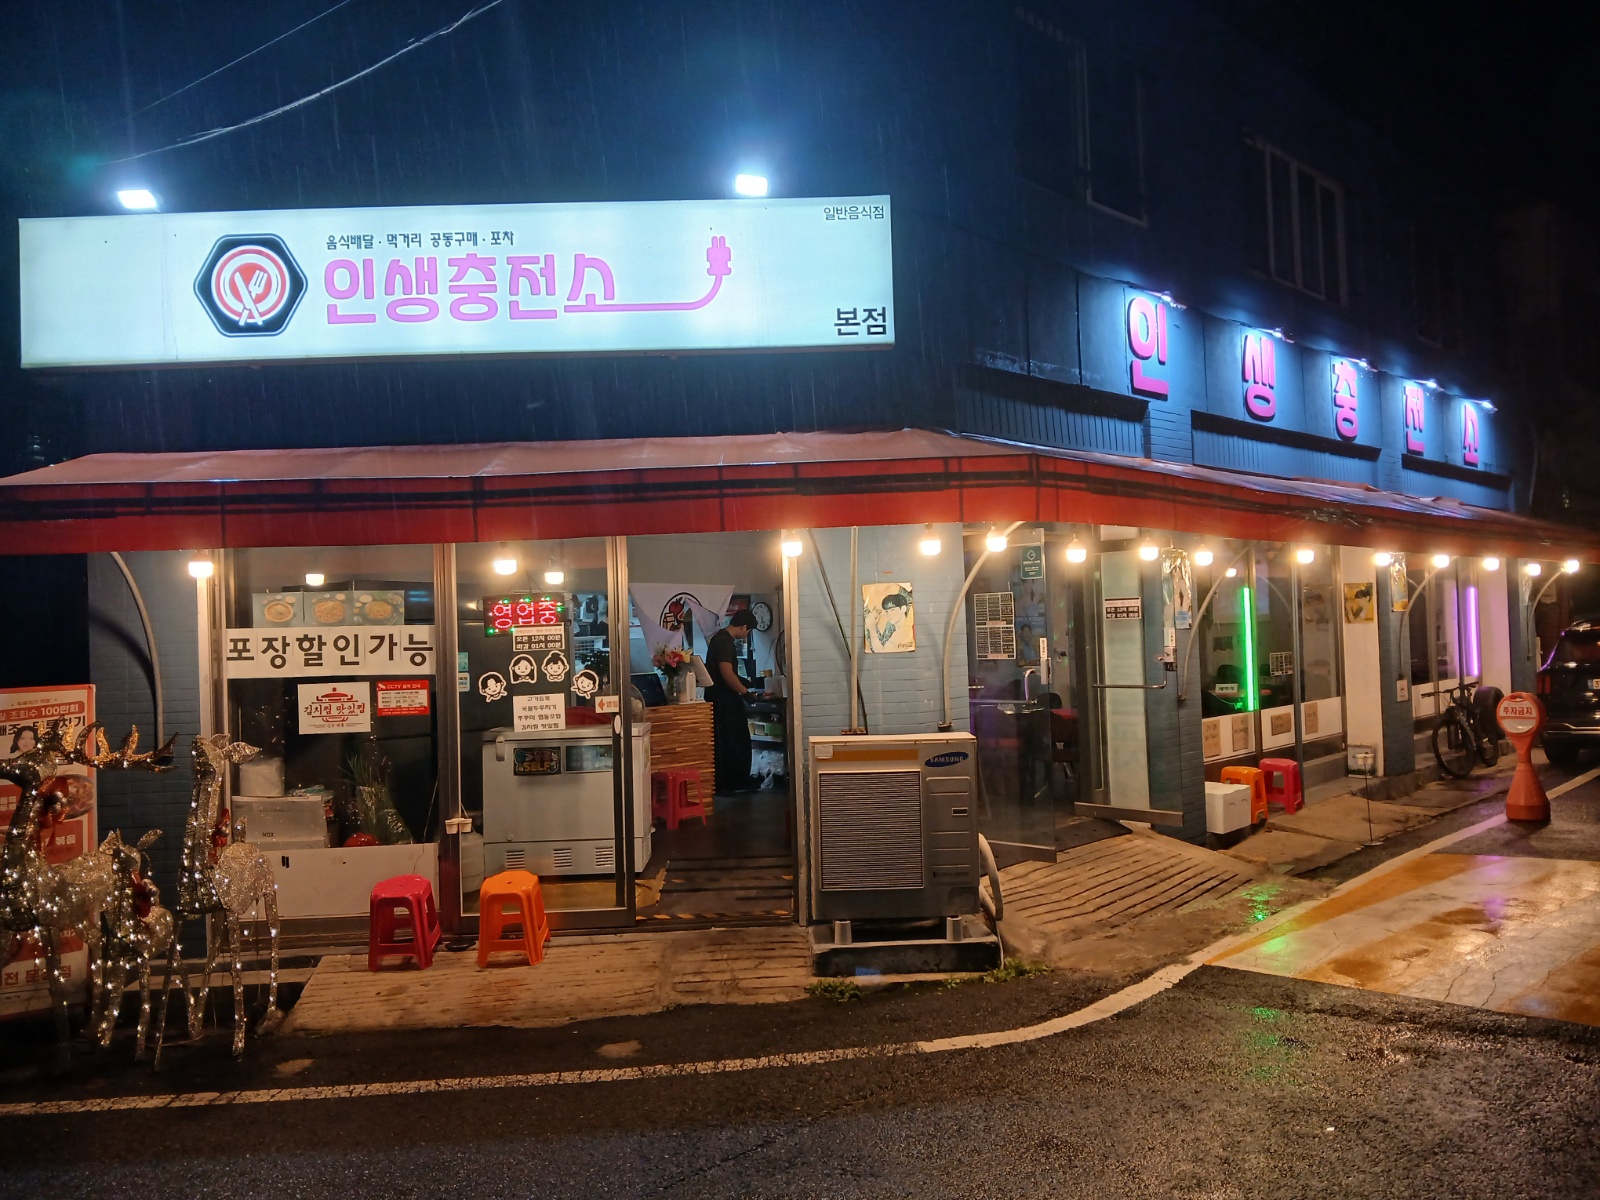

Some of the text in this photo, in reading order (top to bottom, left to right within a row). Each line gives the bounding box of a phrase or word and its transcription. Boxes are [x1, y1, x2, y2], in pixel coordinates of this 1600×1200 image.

[824, 205, 884, 220] 일반음식점
[326, 230, 514, 250] 음식배달 먹거리 공동구매 포차
[324, 253, 615, 324] 인생충전소
[834, 306, 887, 336] 본점
[1127, 296, 1479, 467] 인생충전소
[493, 601, 557, 628] 영업중
[226, 633, 434, 669] 포장할인가능
[10, 708, 38, 720] 조회수
[41, 703, 79, 716] 100만회
[304, 704, 332, 716] 김치찜
[523, 761, 551, 772] SELF
[929, 755, 964, 763] SAMSUNG
